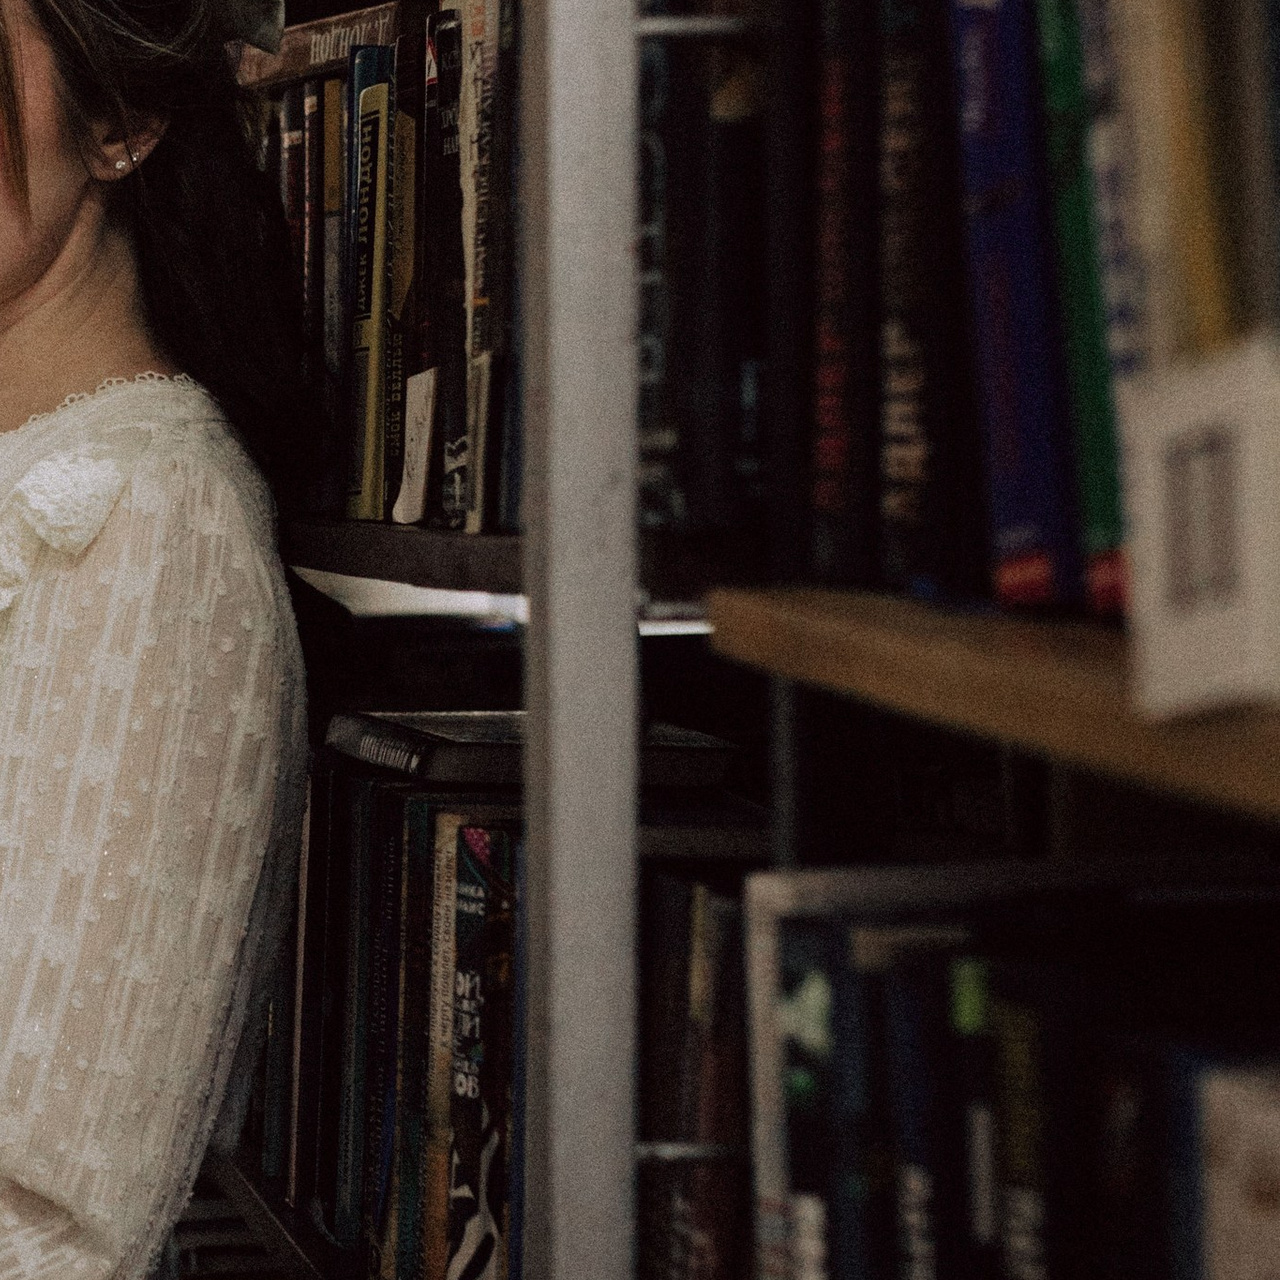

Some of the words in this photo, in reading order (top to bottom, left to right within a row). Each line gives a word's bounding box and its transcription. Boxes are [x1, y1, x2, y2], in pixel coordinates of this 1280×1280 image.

[357, 122, 373, 244] ЛОНДОН
[356, 252, 369, 310] ДЖЕК
[390, 410, 401, 456] СМОК
